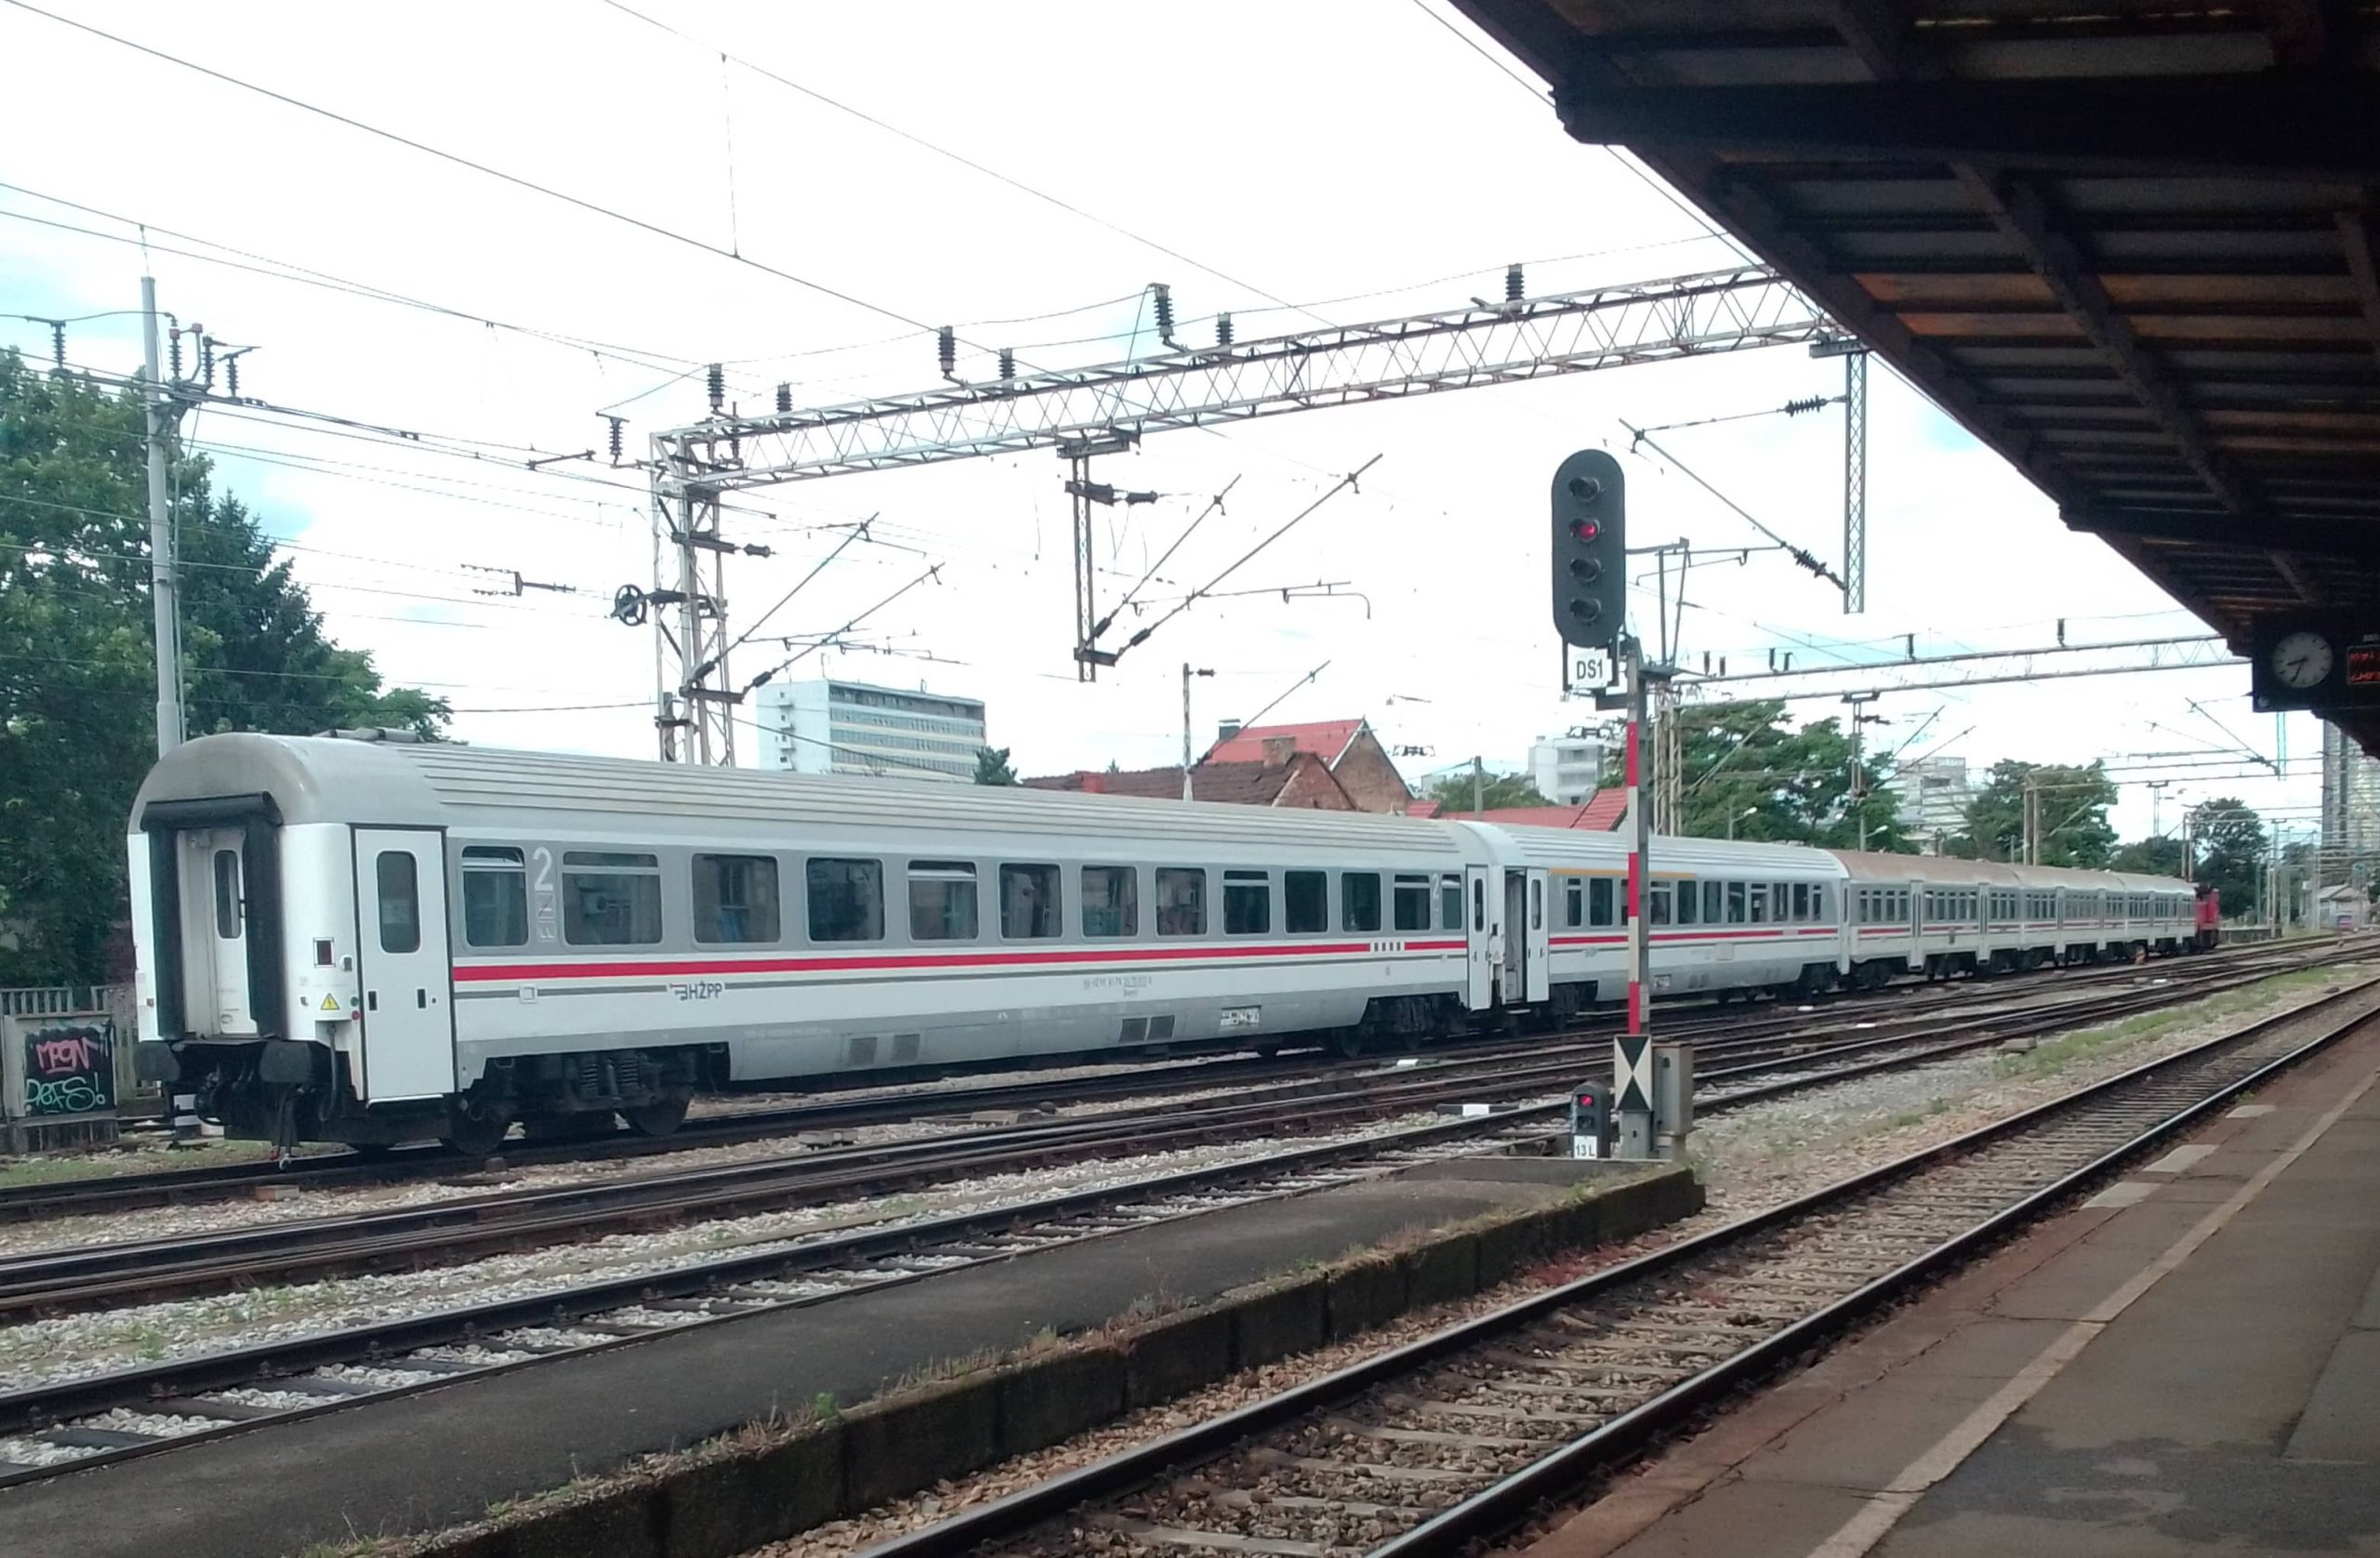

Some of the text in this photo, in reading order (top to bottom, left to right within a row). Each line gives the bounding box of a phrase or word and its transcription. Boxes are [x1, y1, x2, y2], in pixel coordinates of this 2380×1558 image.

[1577, 659, 1603, 680] DS1
[533, 846, 554, 891] 2
[1433, 873, 1440, 900] 2
[689, 981, 722, 999] HŽPP
